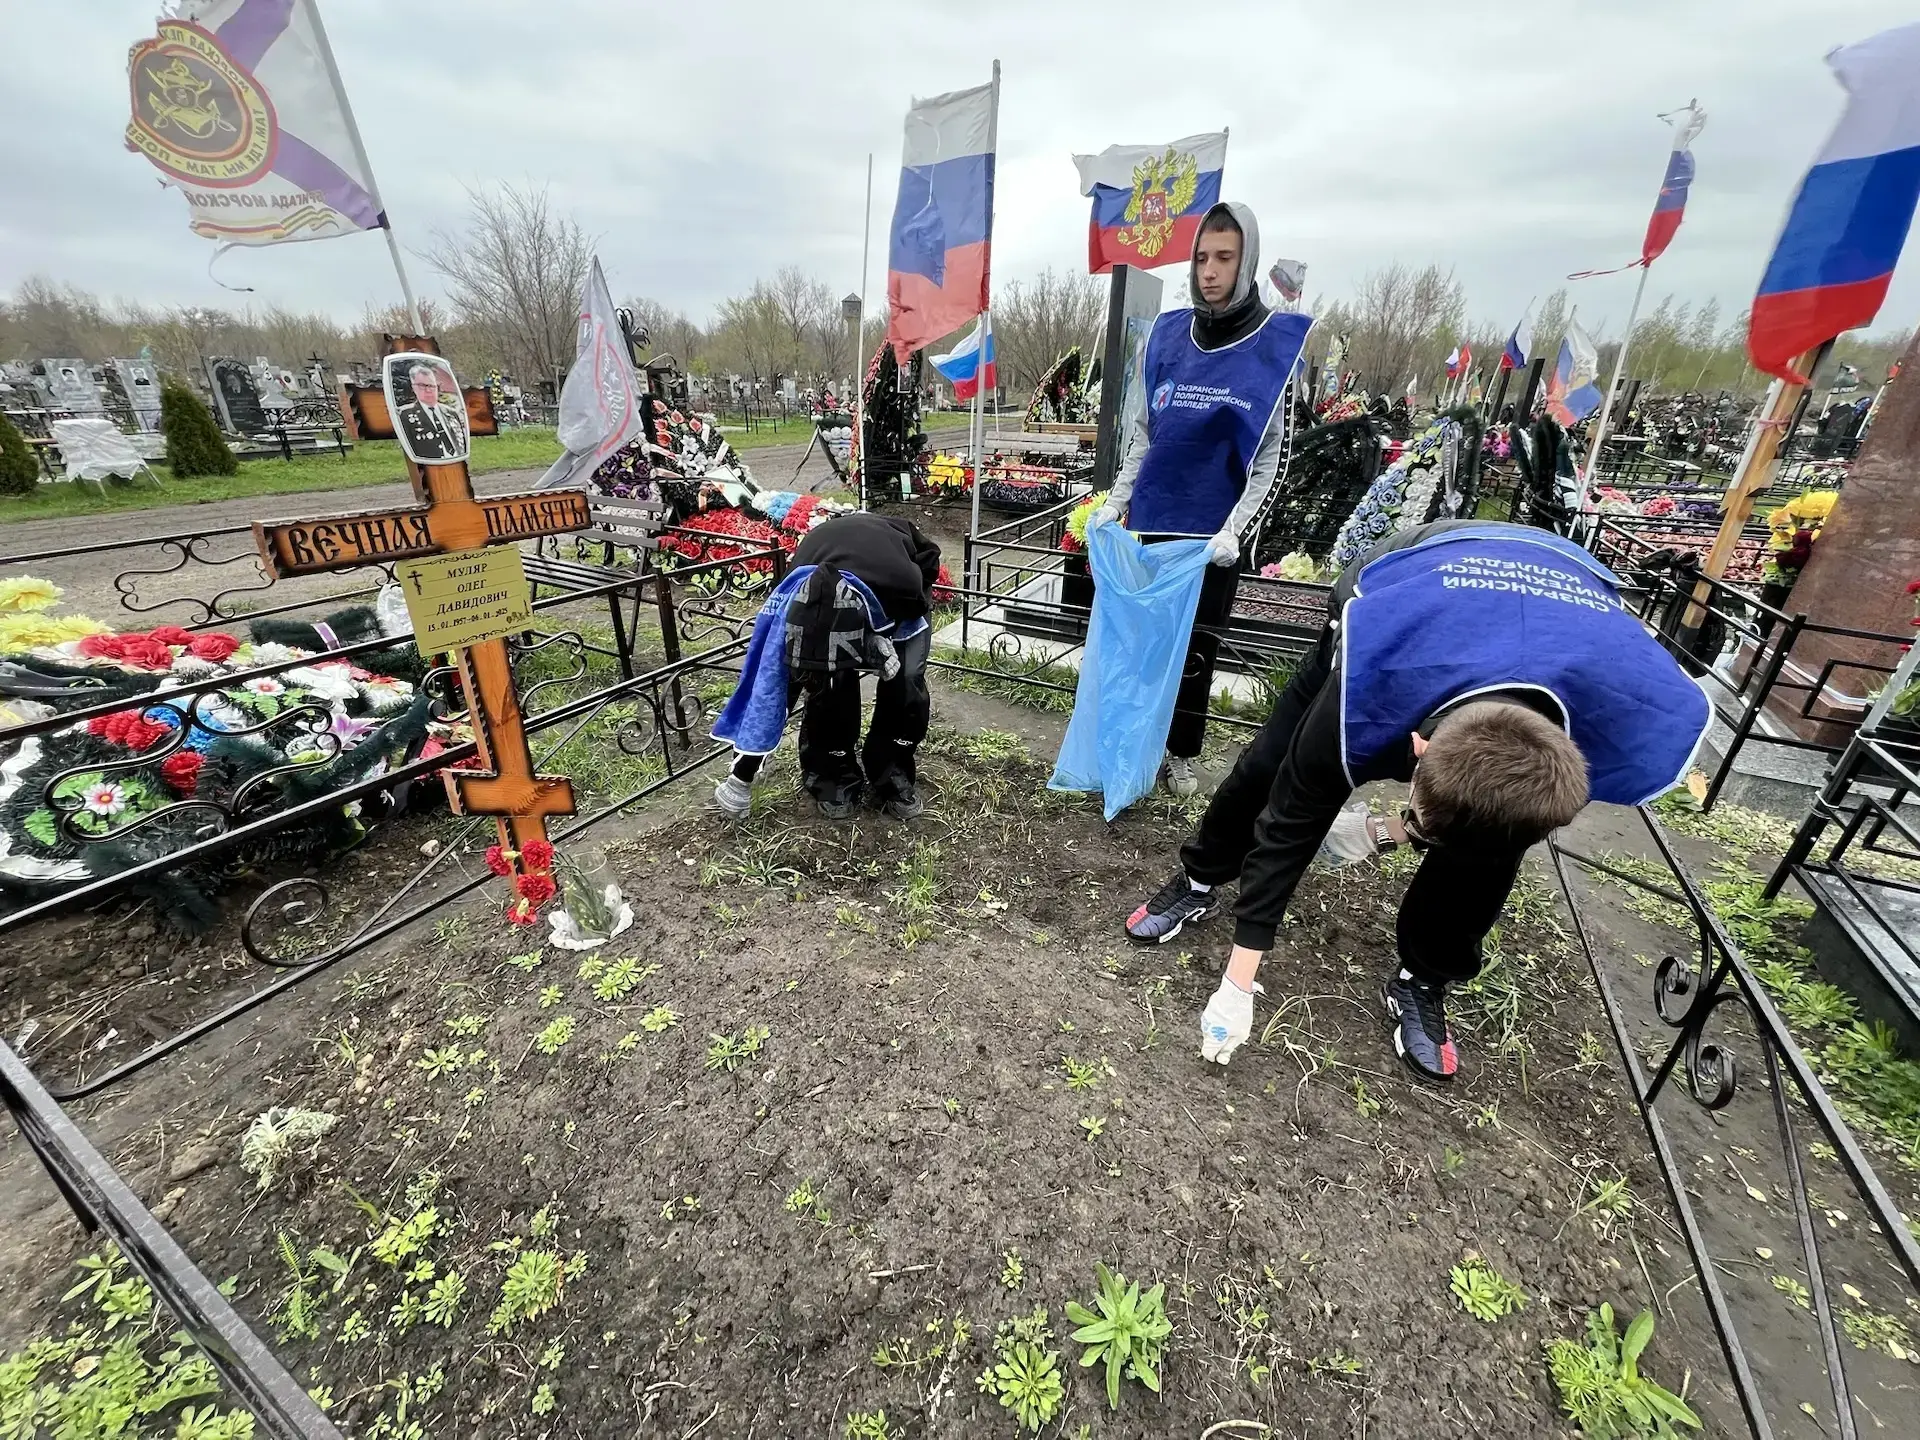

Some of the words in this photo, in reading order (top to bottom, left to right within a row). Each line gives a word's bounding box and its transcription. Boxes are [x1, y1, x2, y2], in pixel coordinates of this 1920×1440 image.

[1176, 383, 1230, 396] СЫЗРАНСКИЙ
[1171, 400, 1212, 410] КОЛЛЕДЖ
[1174, 392, 1252, 411] ПОЛИТЕХНИЧЕСКИЙ
[287, 514, 436, 567] ВЕЧНАЯ
[482, 498, 586, 539] ПАМЯТЬ
[447, 563, 488, 579] МУЛЯР
[1461, 557, 1582, 584] КОЛЛЕДЖ
[457, 579, 487, 593] ОЛЕГ
[1438, 563, 1621, 609] ОЛИТЕХНИЧЕСК
[1442, 576, 1610, 612] СЫЗРАНСКИЙ
[436, 590, 508, 616] ДАВИДОВИЧ
